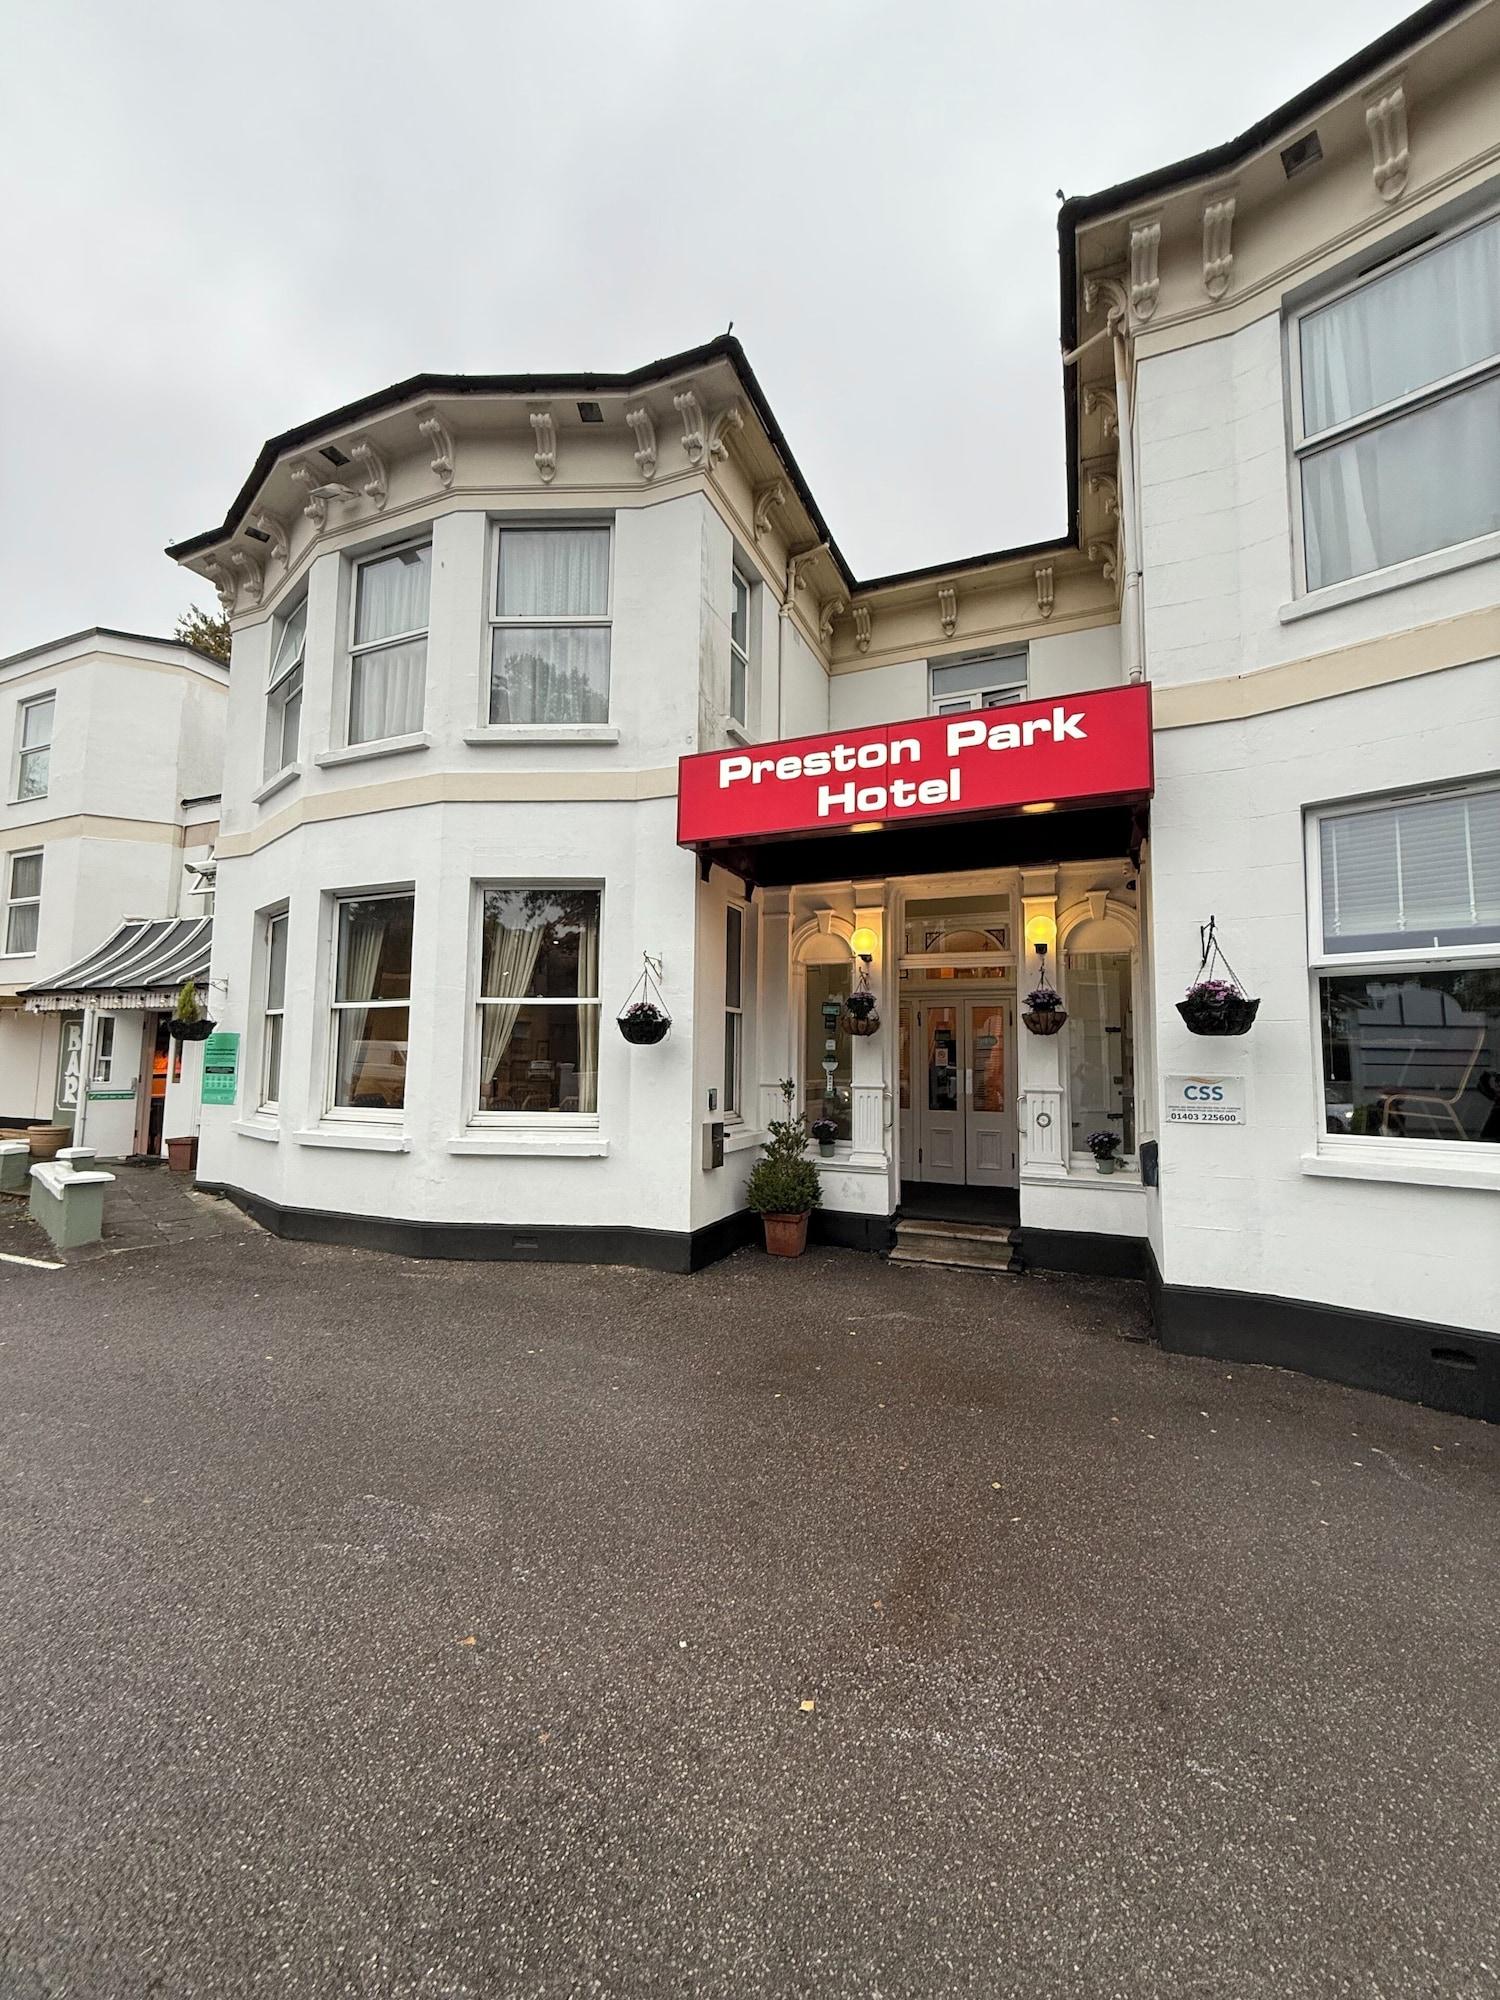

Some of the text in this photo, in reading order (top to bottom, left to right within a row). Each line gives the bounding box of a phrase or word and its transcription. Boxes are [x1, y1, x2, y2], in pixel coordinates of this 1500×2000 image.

[719, 706, 1088, 789] Preston Park
[817, 767, 961, 817] Hotel
[63, 1025, 81, 1104] BAR
[1171, 1112, 1236, 1122] 01403 225600
[1184, 1086, 1223, 1100] CSS
